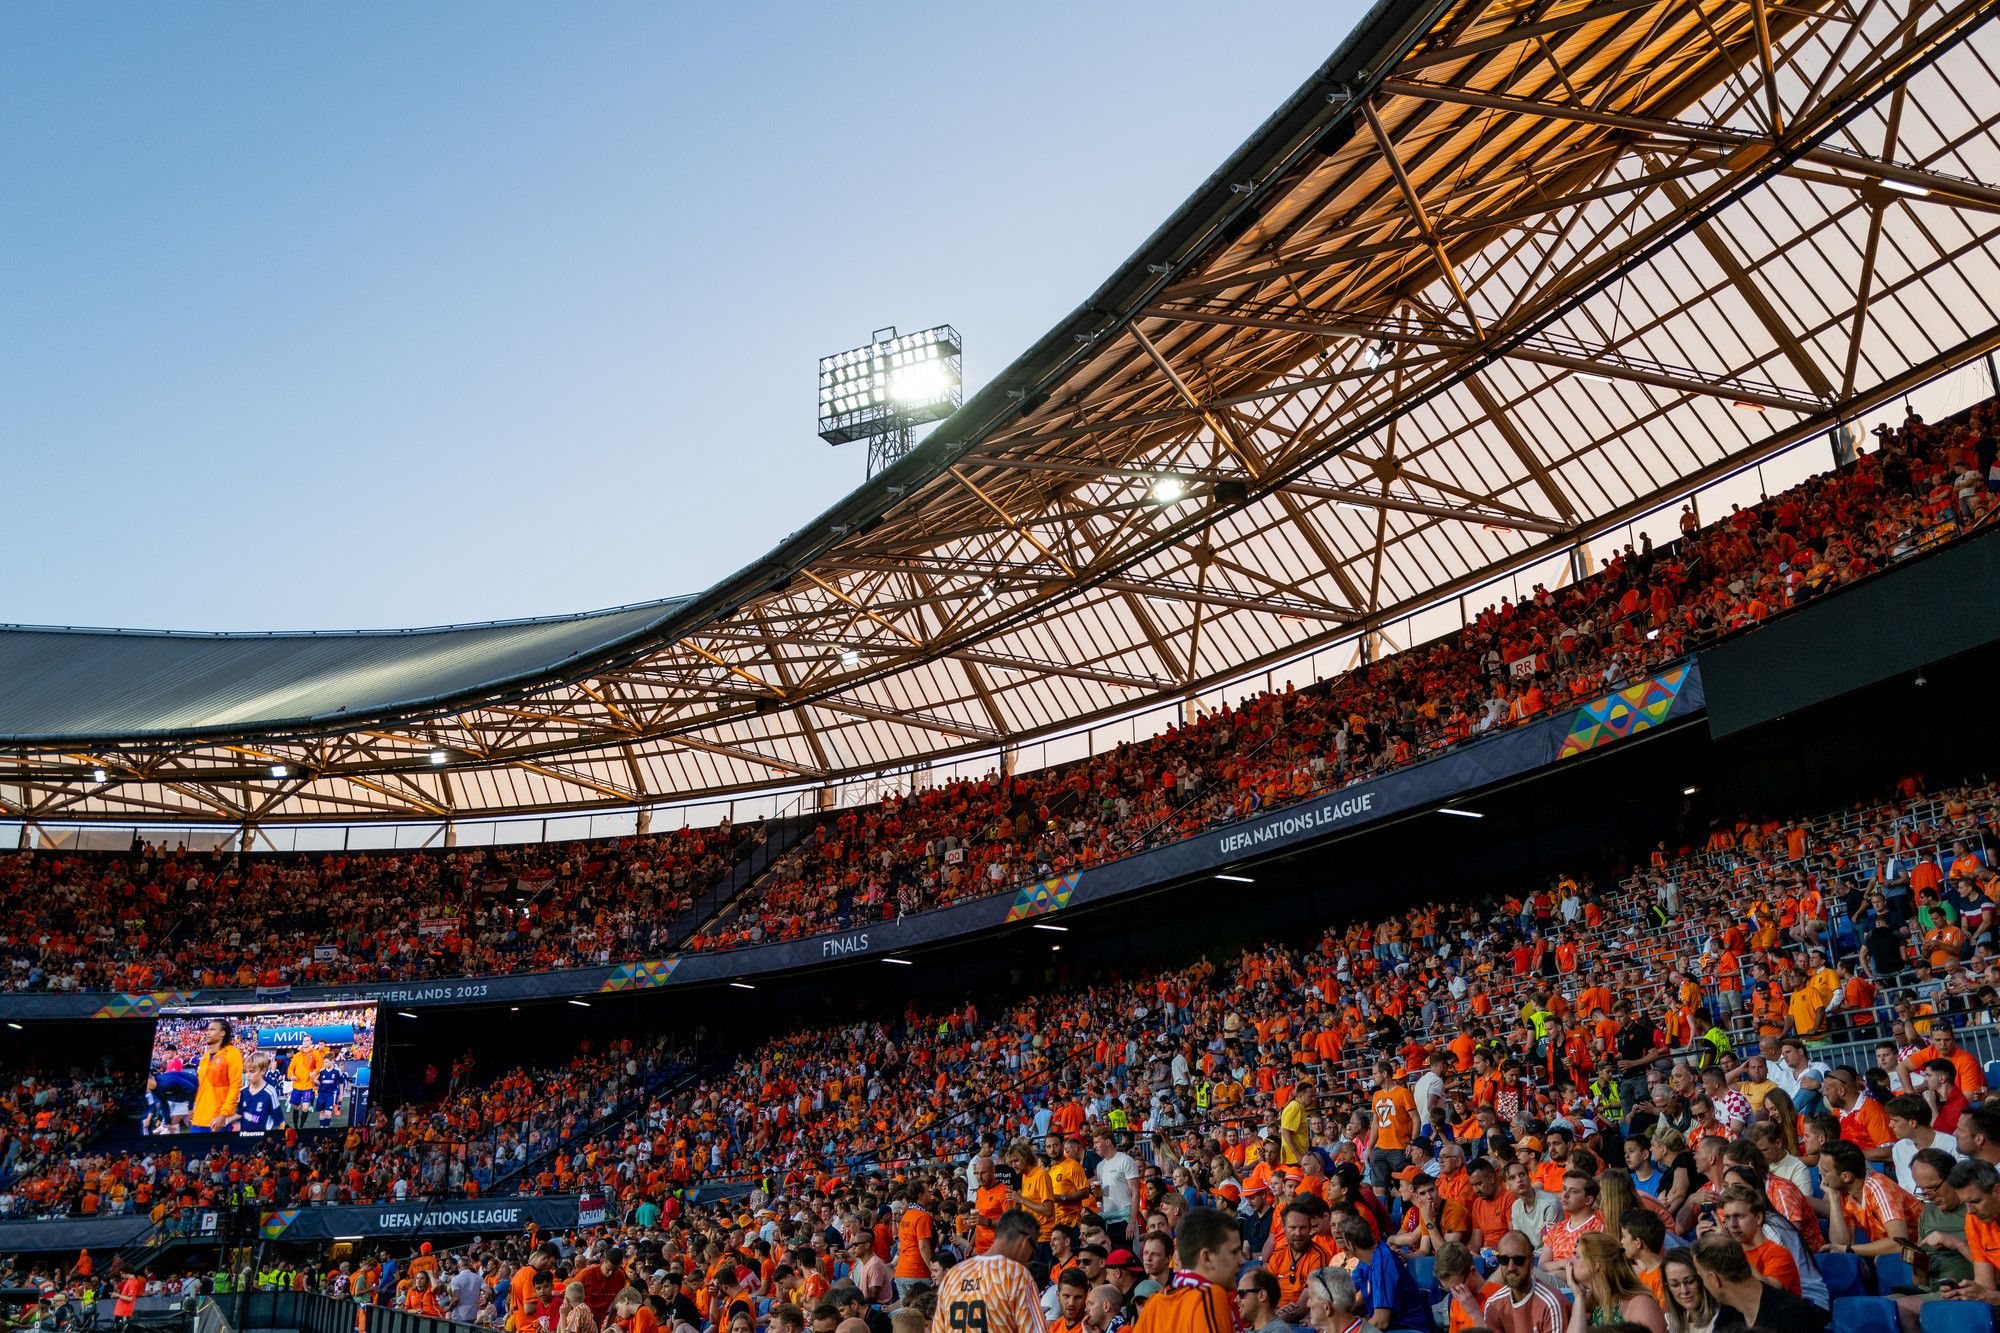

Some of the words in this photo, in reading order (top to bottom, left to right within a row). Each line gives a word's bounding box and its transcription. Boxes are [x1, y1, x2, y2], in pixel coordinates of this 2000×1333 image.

[1516, 661, 1532, 675] RR
[1220, 832, 1253, 853] UEFA
[1254, 812, 1314, 844] NATIONS
[823, 933, 869, 957] FINALS
[456, 985, 488, 998] 2023
[206, 1216, 213, 1227] P
[379, 1213, 411, 1228] UEFA
[413, 1210, 469, 1226] NATIONS
[950, 1300, 988, 1333] 99
